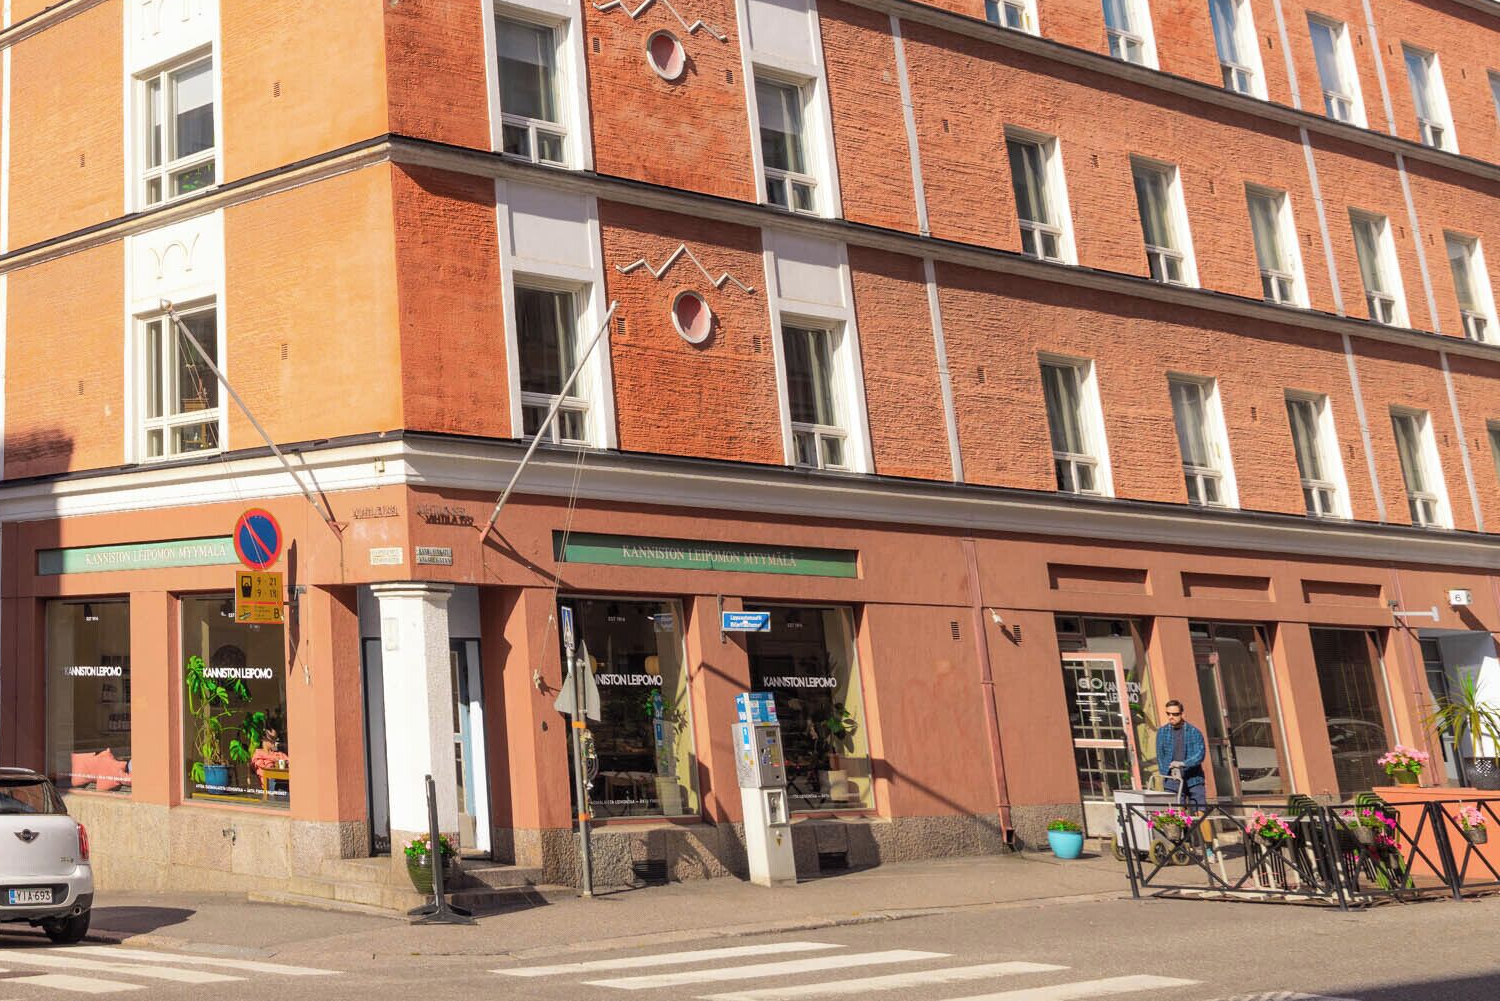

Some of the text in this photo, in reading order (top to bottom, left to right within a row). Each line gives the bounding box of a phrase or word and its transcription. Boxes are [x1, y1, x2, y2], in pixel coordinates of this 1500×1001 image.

[85, 551, 131, 566] KANNISTON
[622, 545, 796, 566] KANNISTON LEIPOMON MYYMÄLÄ
[274, 608, 279, 619] B
[64, 666, 96, 676] KANNISTON
[203, 667, 273, 679] KANNISTON LEIPOMO
[627, 674, 663, 685] LEIPOMO
[764, 676, 837, 687] KANNISTON LEIPOMO
[17, 890, 51, 901] YIA-693
